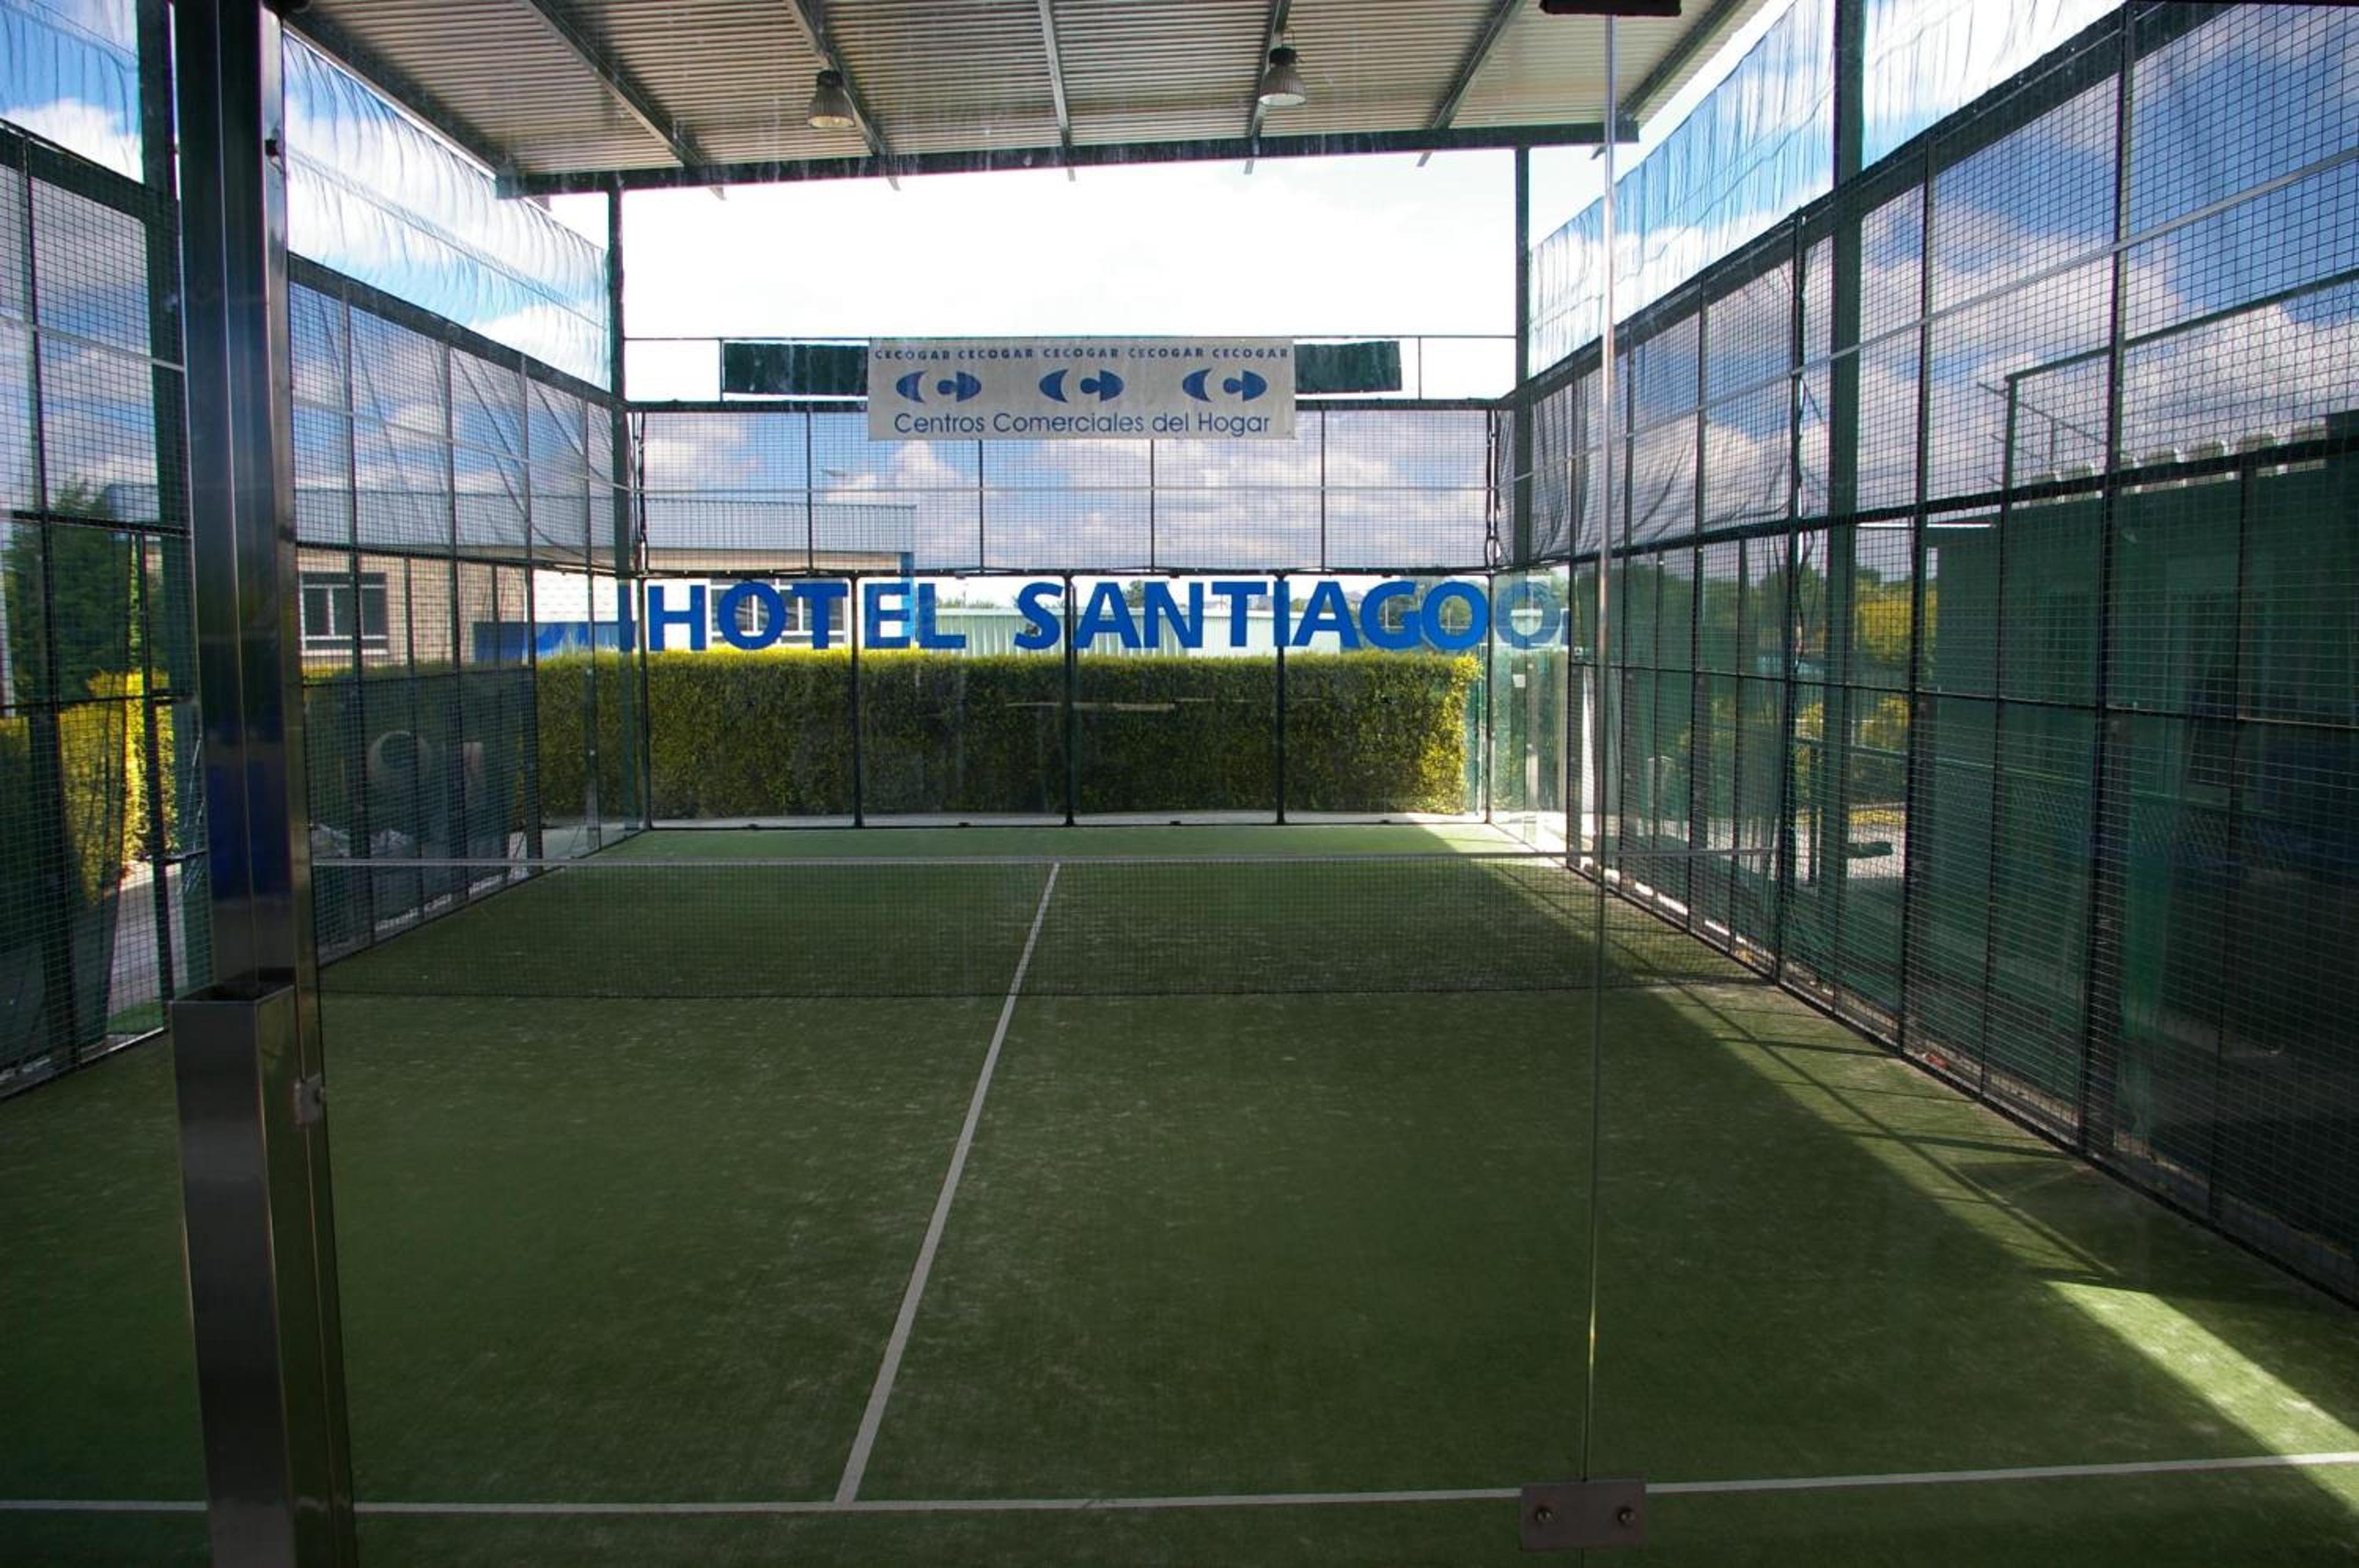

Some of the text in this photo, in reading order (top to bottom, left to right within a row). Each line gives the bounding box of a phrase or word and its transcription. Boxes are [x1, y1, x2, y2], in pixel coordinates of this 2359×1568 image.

[874, 347, 1288, 360] CECOGAR CECOGAR CECOGAR CECOGAR CECOGAR
[894, 412, 1271, 436] Centros Comerciales del Hogar
[647, 579, 966, 652] HOTEL
[1014, 580, 1489, 650] SANTIAGO
